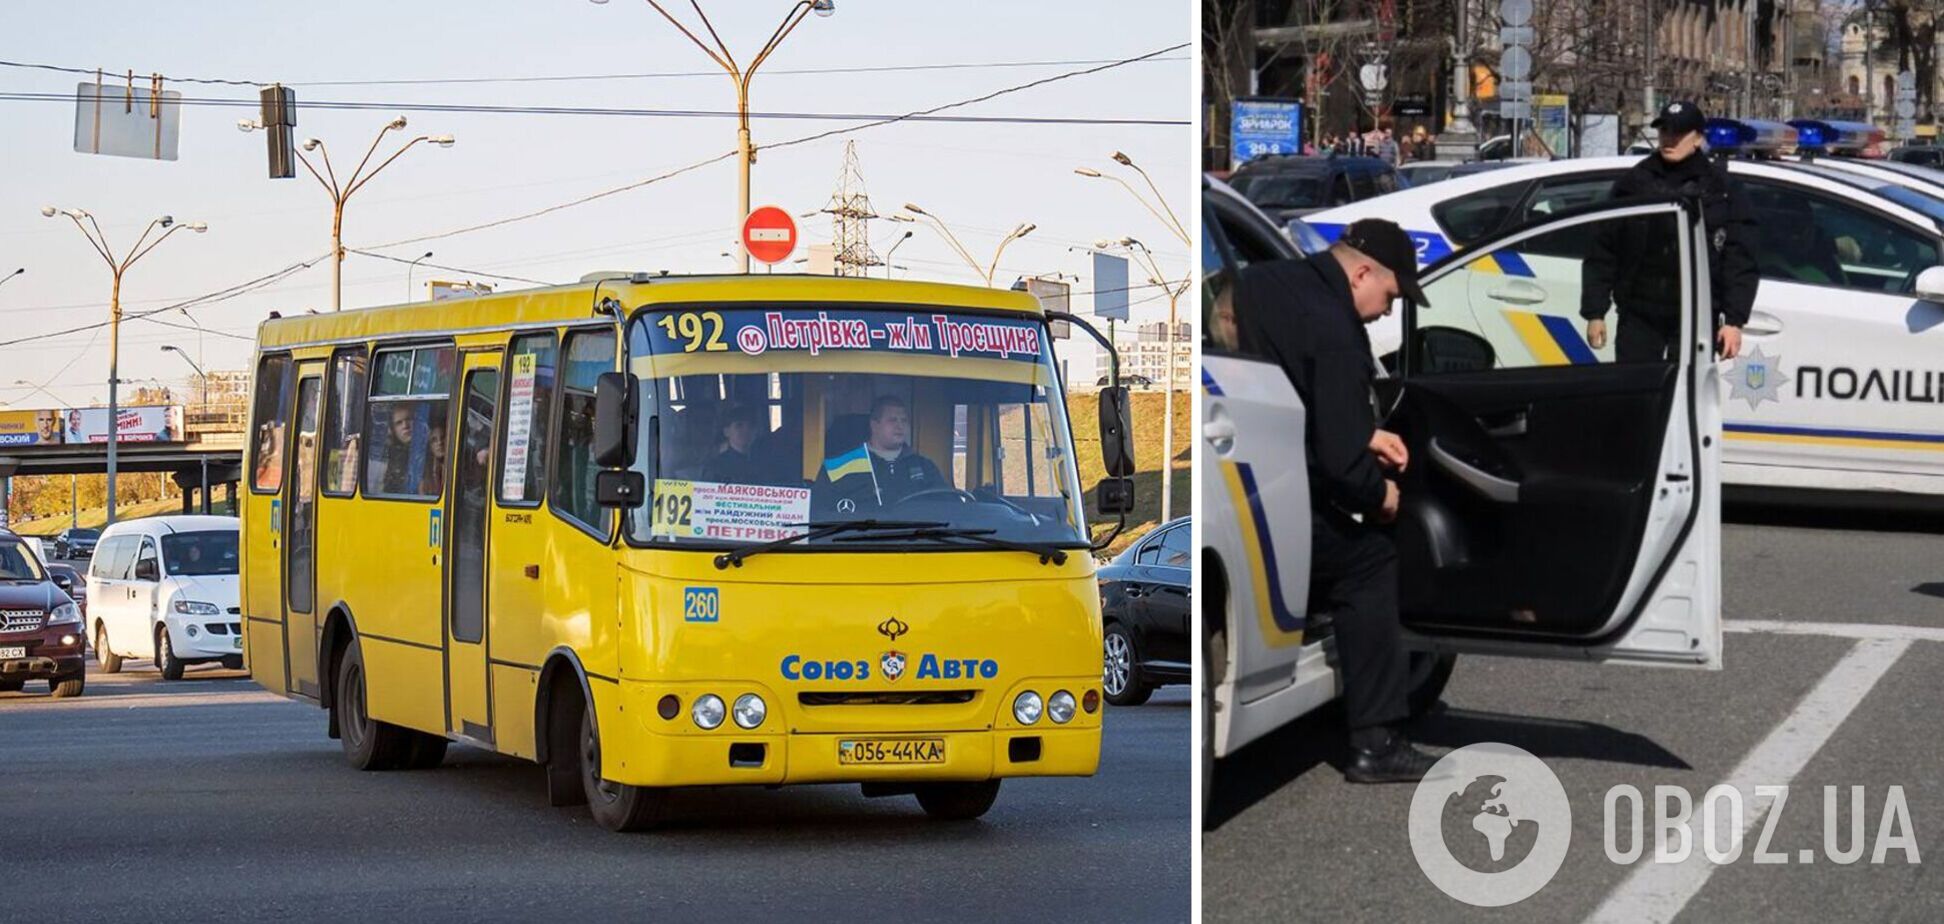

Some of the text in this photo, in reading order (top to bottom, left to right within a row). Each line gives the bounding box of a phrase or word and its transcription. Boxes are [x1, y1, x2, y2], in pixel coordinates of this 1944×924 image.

[657, 311, 728, 352] 192
[766, 312, 868, 355] Петрівка
[886, 318, 932, 350] ж/м
[932, 314, 1041, 358] Троєщина
[519, 356, 530, 374] 192
[654, 493, 692, 526] 192
[686, 591, 718, 618] 260
[780, 655, 870, 680] Союз
[916, 653, 998, 679] Авто
